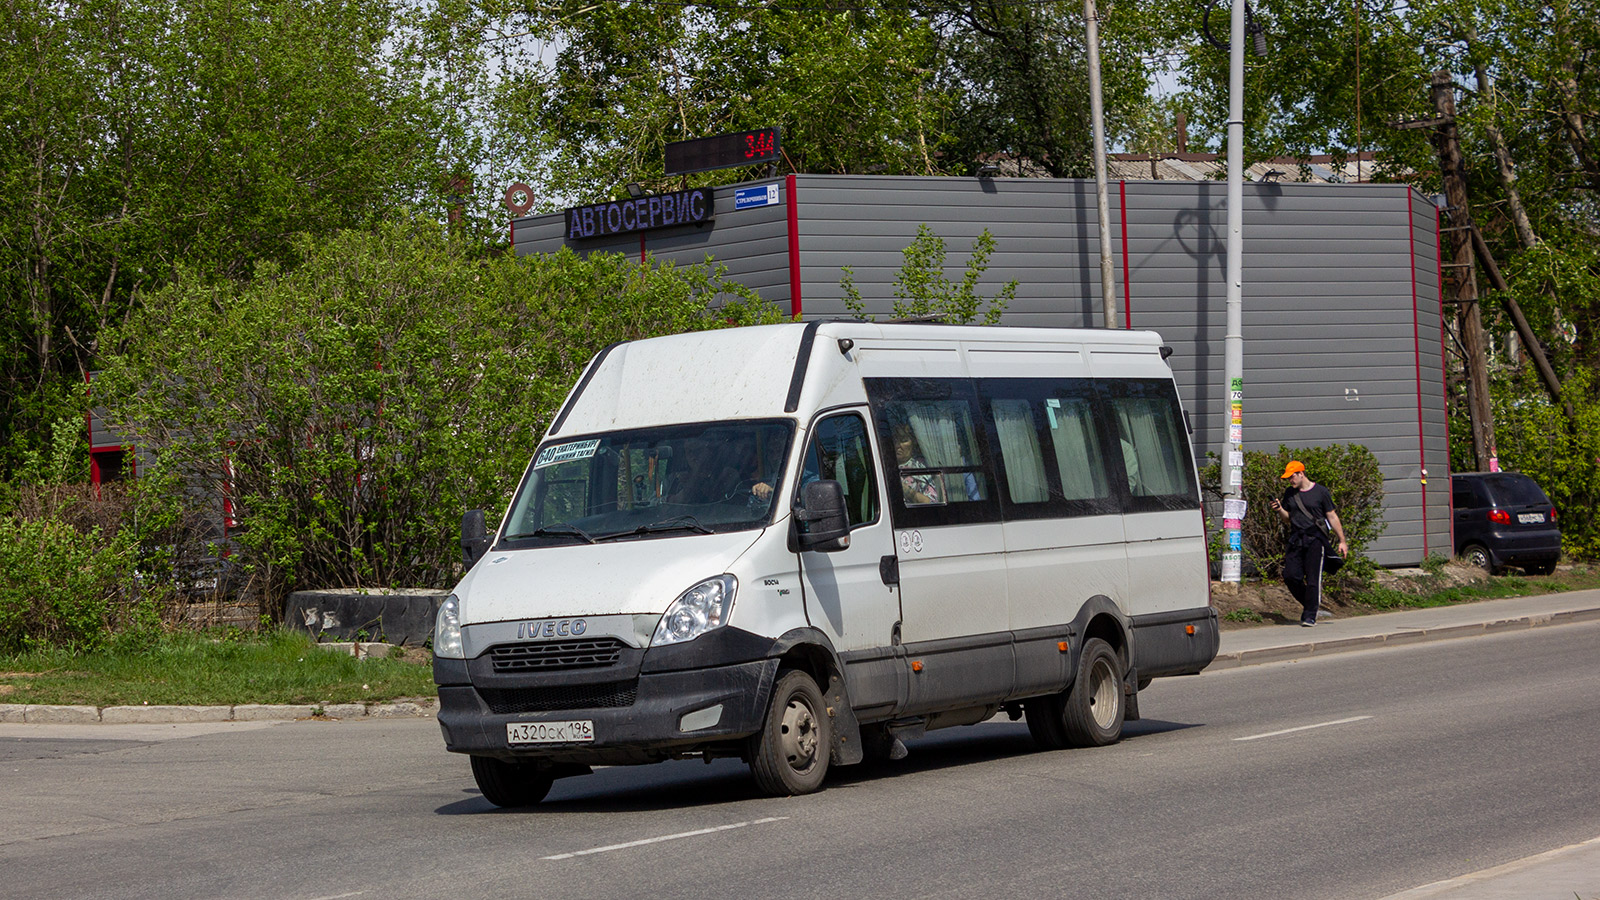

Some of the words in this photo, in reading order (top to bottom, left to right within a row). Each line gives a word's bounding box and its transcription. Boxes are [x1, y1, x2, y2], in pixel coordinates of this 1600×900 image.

[745, 131, 774, 159] 344
[569, 190, 704, 239] АВТОСЕРВИС
[537, 447, 557, 465] 640
[557, 440, 598, 454] ЕКАТЕРИНБУРГ
[576, 449, 595, 459] ТАГИЛ
[517, 619, 587, 639] IVECO
[512, 724, 566, 741] А320СК
[568, 721, 589, 735] 196
